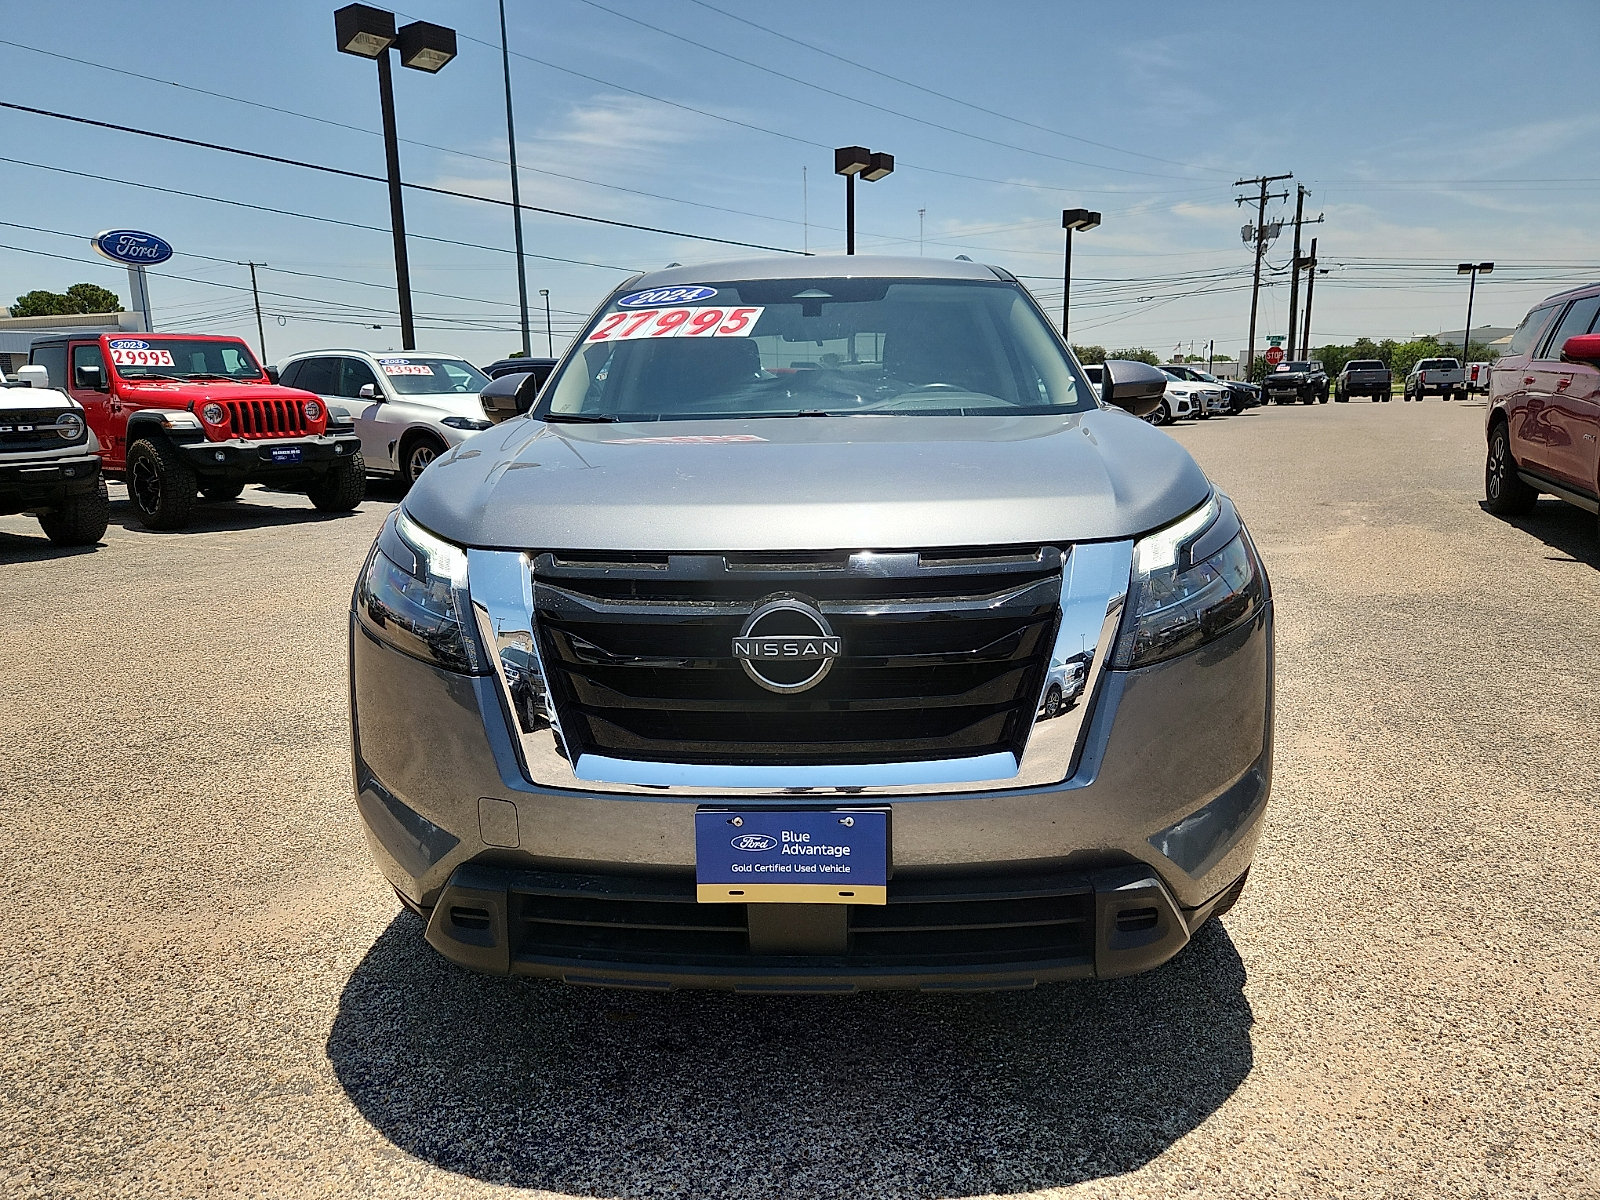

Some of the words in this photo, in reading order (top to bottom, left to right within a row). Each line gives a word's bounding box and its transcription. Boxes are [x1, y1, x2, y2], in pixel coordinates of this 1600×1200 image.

[116, 235, 159, 258] Ford
[629, 288, 703, 305] 2024
[589, 308, 759, 341] 27995
[117, 341, 143, 349] 2023
[113, 349, 171, 365] 29995
[1266, 351, 1283, 360] STOP
[385, 365, 431, 374] 43995
[735, 641, 838, 656] NISSAN
[739, 836, 768, 850] Ford
[781, 830, 811, 842] Blue
[781, 843, 851, 858] Advantage
[731, 863, 752, 873] Gold
[754, 863, 792, 873] Certified
[794, 864, 817, 873] Used
[819, 864, 851, 873] Vehicle
